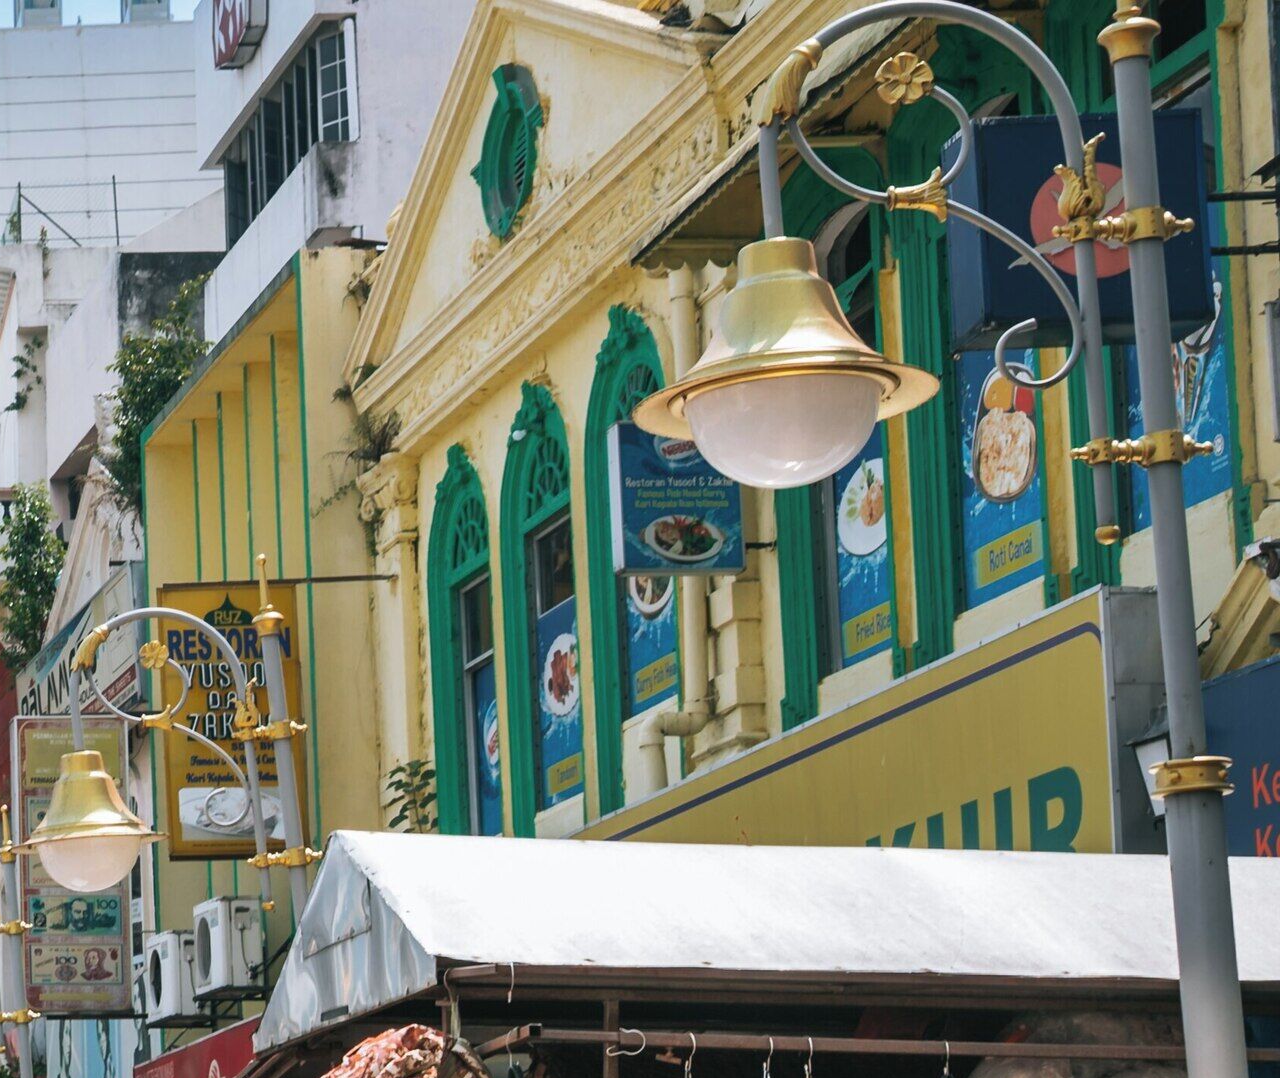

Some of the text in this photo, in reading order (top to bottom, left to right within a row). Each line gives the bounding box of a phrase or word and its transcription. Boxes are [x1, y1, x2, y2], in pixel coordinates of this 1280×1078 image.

[989, 534, 1033, 571] Roti Canai
[167, 627, 291, 661] RESTORN
[856, 621, 874, 642] Fried
